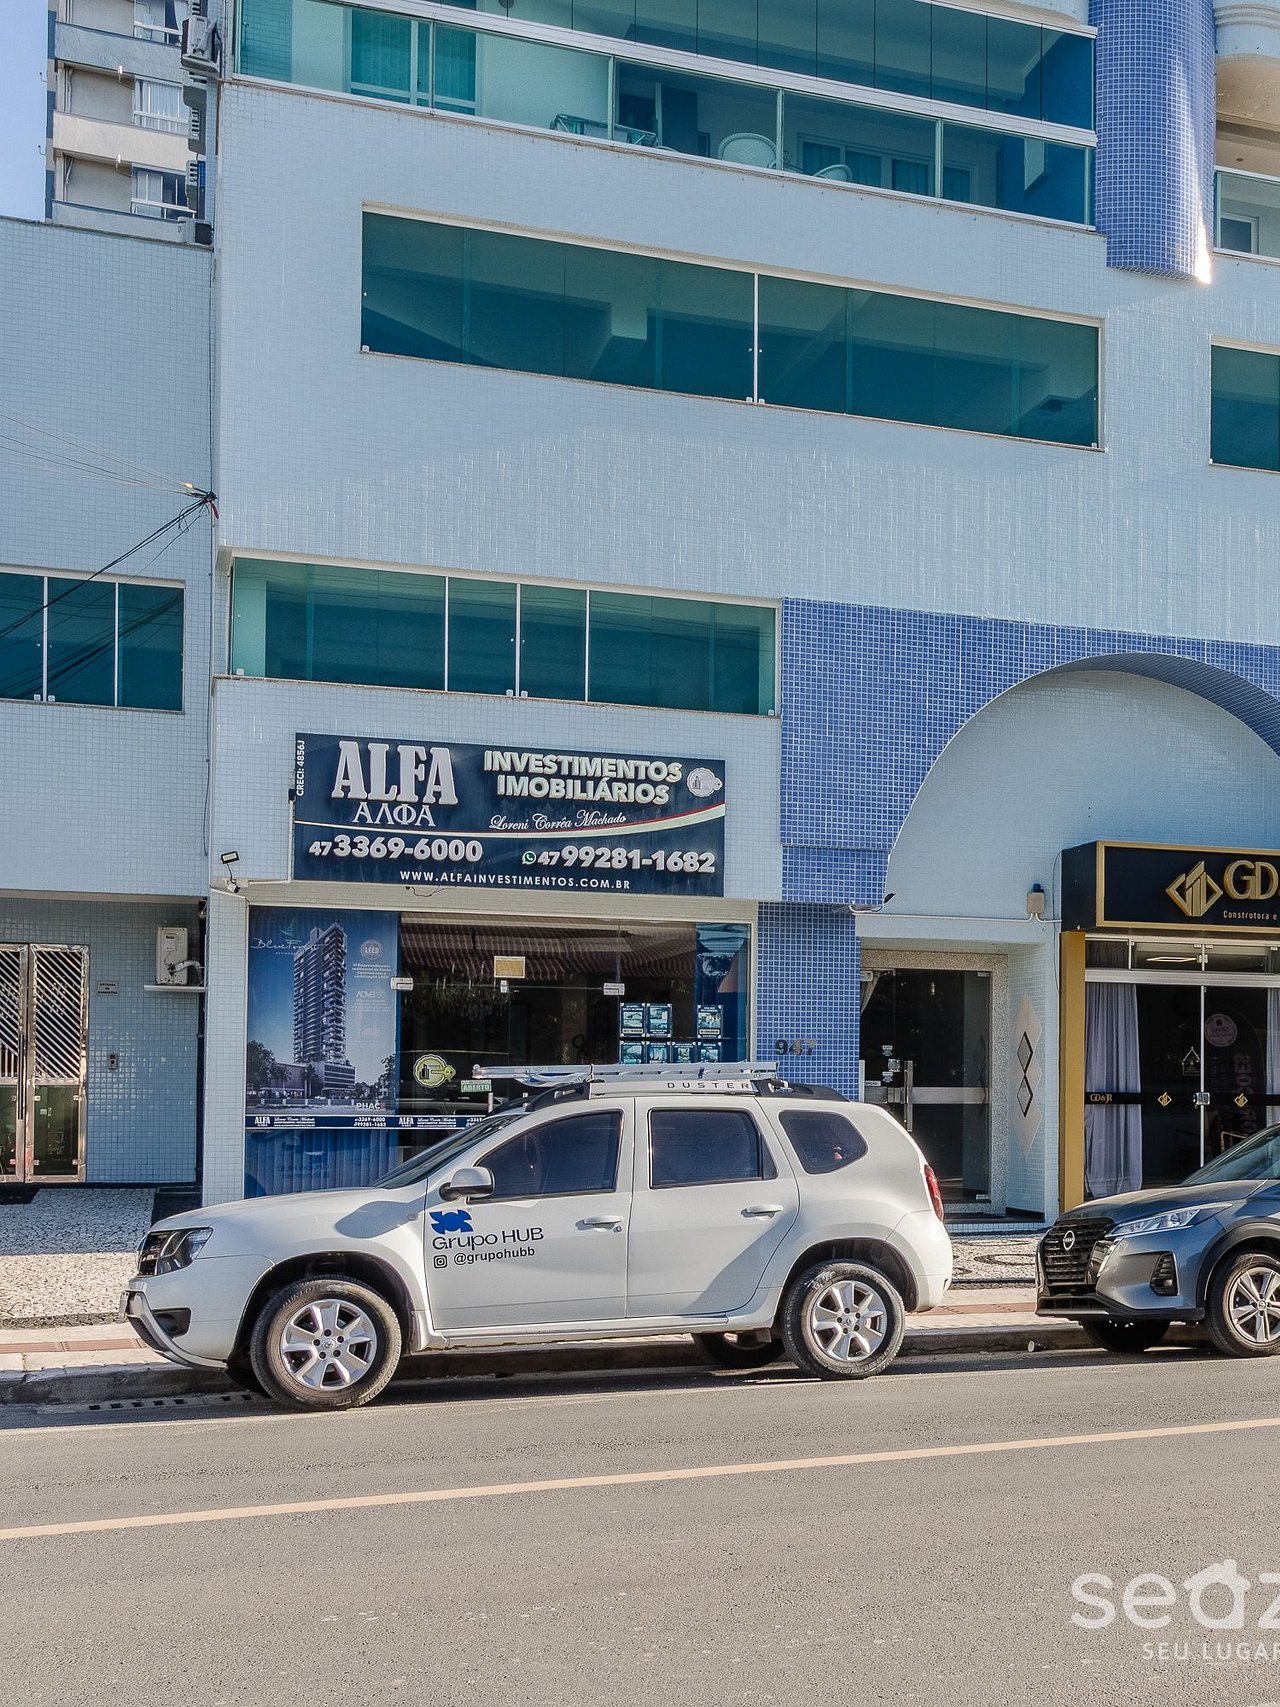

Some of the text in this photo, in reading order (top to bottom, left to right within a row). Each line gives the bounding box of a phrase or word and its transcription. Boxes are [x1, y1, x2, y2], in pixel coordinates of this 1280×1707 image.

[296, 740, 305, 796] CRECI: 4856J
[331, 740, 458, 805] ALFA
[483, 750, 683, 783] INVESTIMENTOS
[497, 775, 670, 805] IMOBILIÁRIOS
[488, 809, 627, 831] Loreni Corrêa Machado
[333, 834, 483, 862] 3369-6000
[560, 845, 716, 874] 99281-1682
[399, 870, 631, 890] WWW.ALFAINVESTIMENTOS.COM.BR
[1223, 910, 1269, 920] Construtora
[432, 1227, 544, 1251] Grupo HUB
[454, 1246, 535, 1266] @grupohubb
